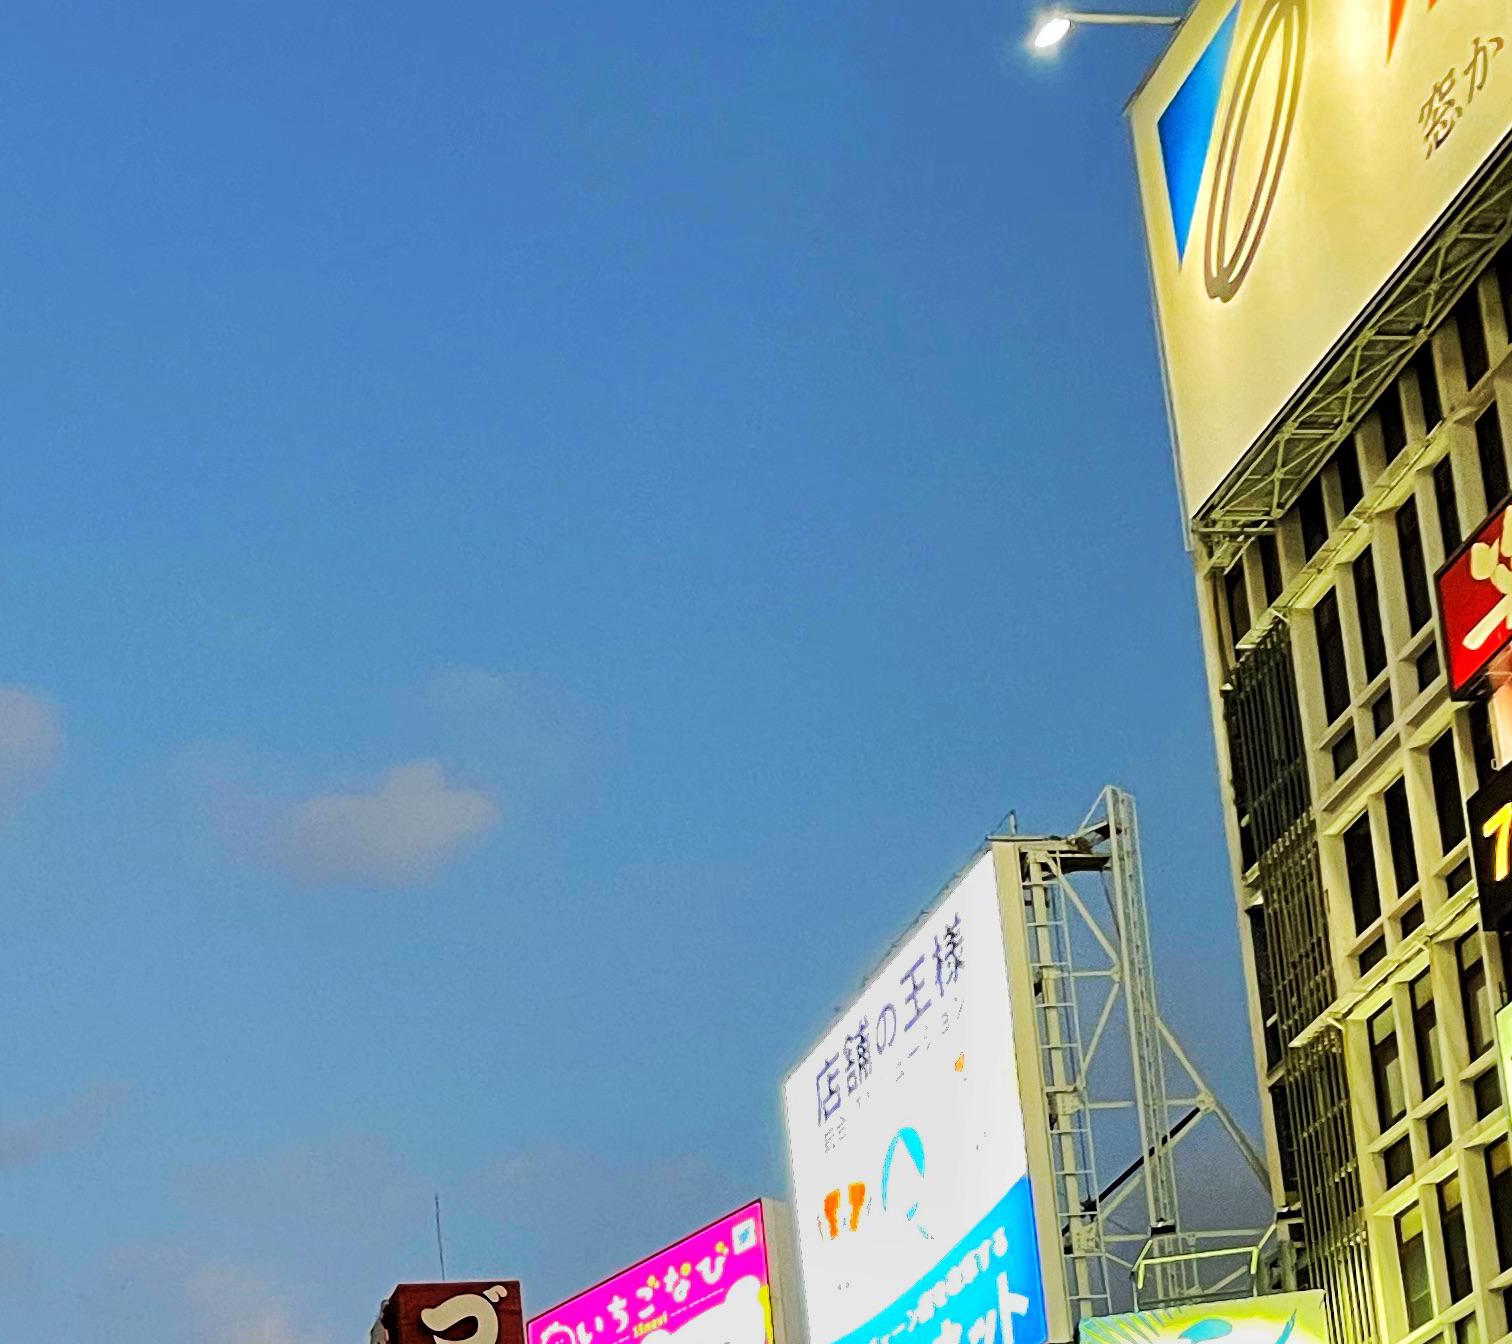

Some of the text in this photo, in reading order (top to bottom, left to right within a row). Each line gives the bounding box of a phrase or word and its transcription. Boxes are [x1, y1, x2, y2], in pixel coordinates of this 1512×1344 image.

[815, 911, 965, 1127] 店舗の王様
